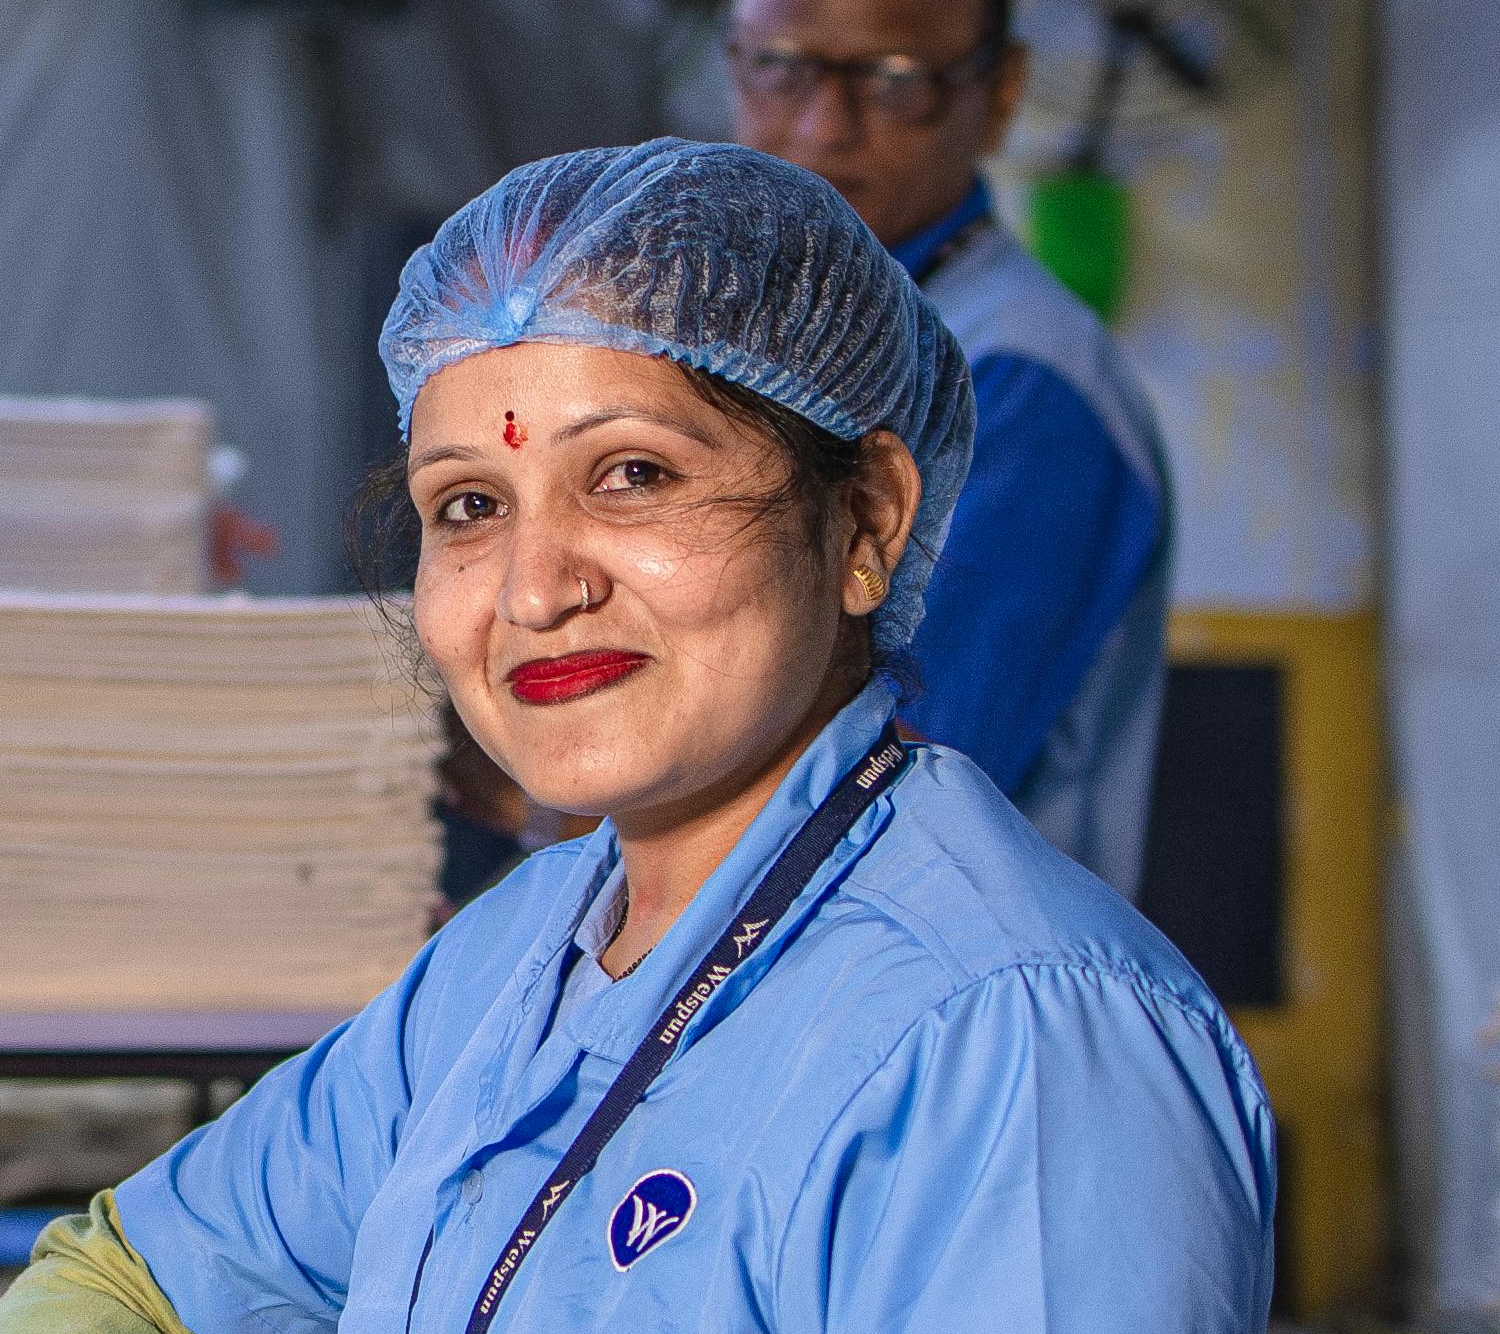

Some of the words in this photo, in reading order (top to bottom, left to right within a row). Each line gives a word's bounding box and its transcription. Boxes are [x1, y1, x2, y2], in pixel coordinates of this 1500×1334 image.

[856, 743, 904, 789] Welspun
[659, 965, 732, 1045] Welspun
[479, 1229, 536, 1314] Welspun
